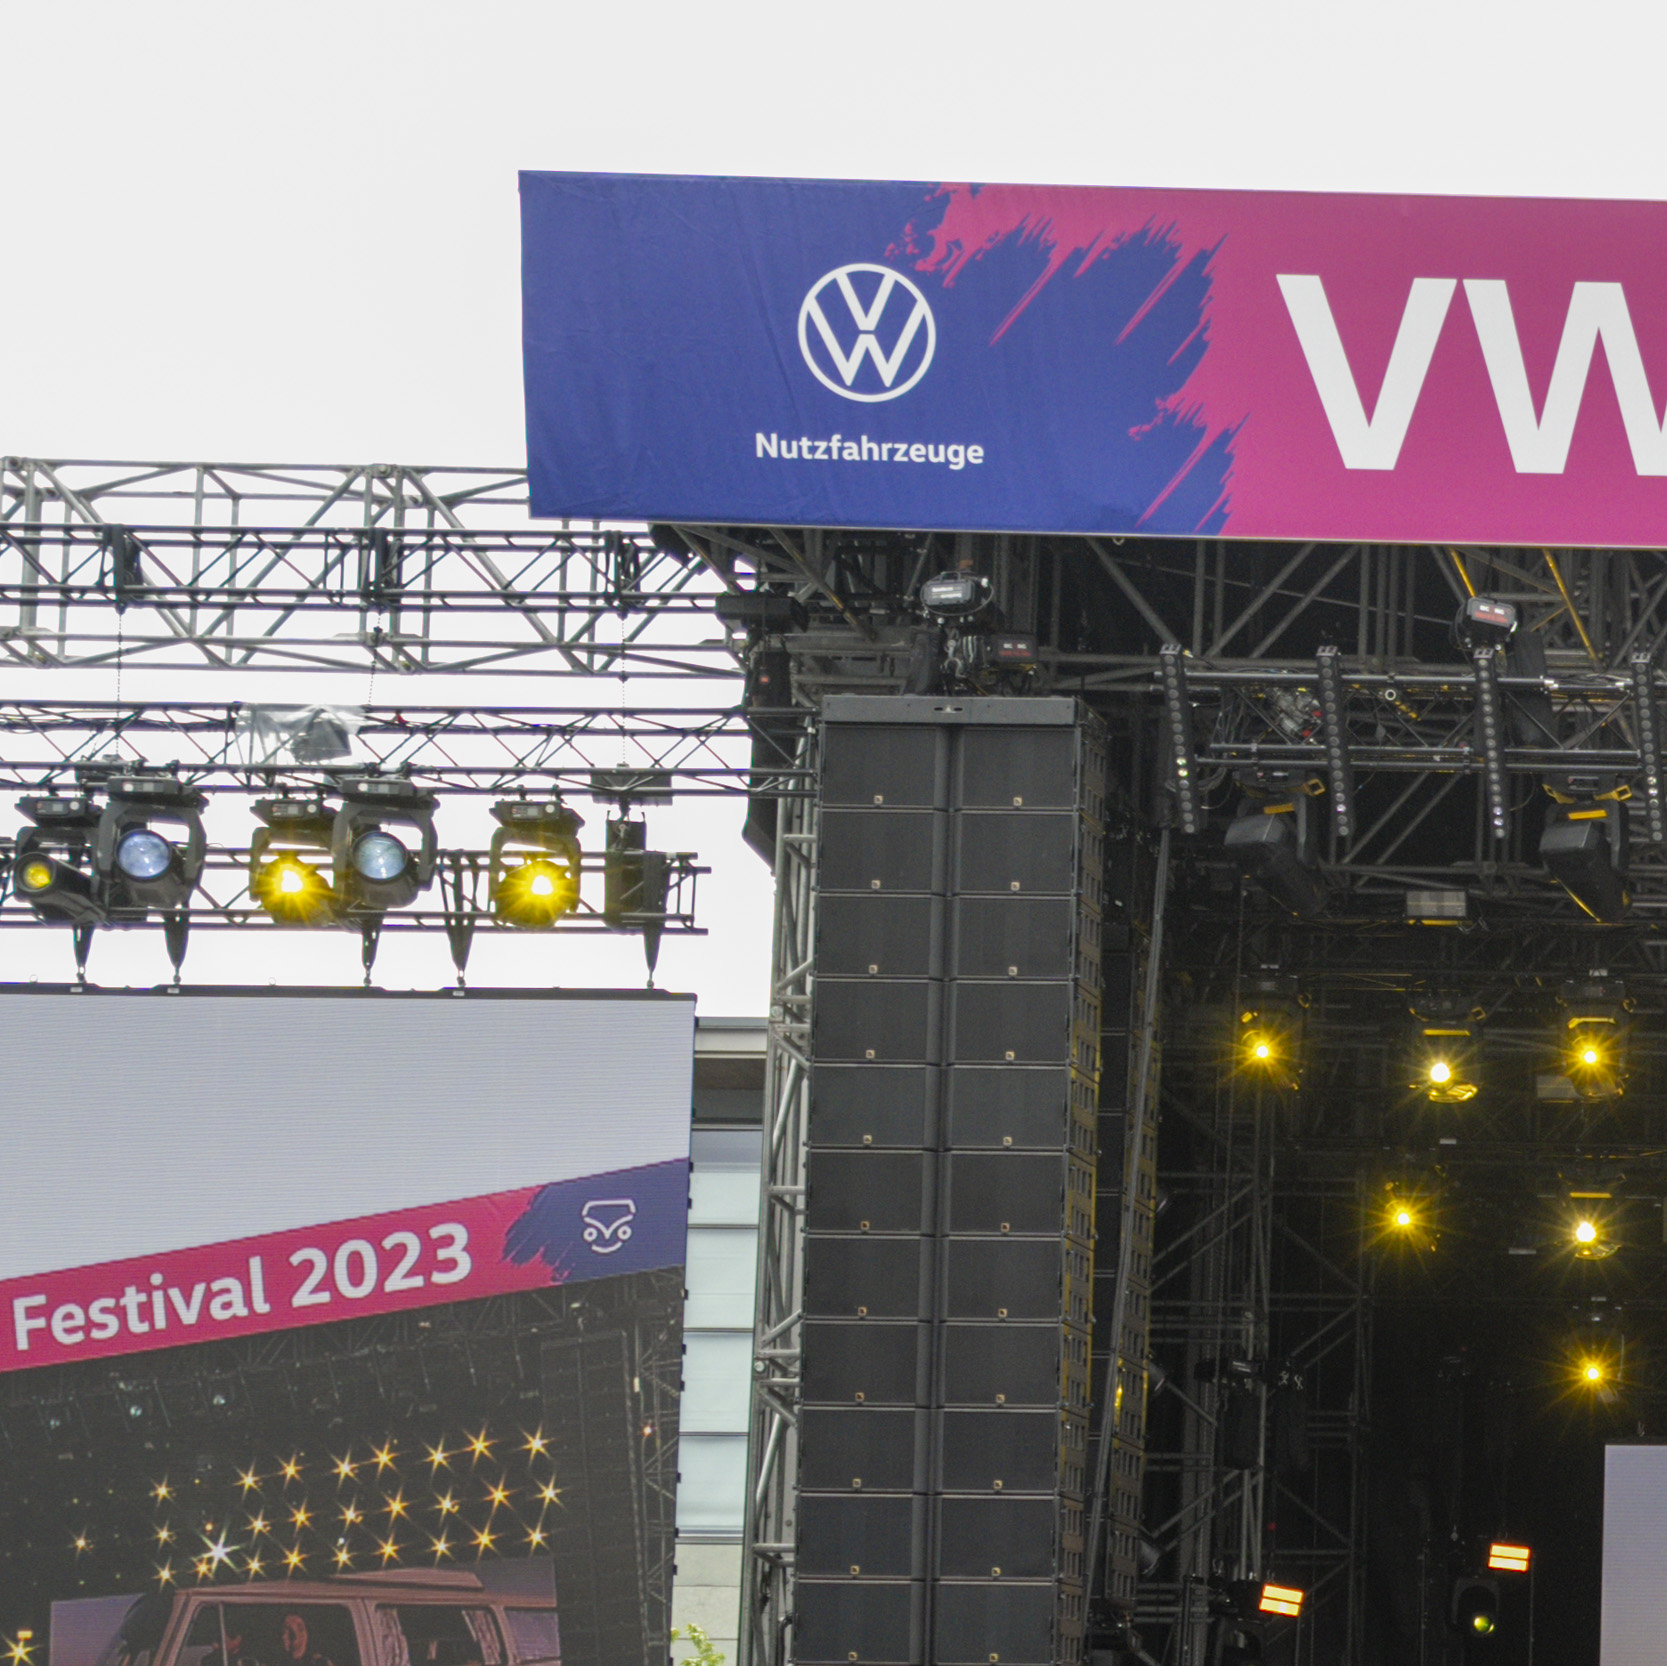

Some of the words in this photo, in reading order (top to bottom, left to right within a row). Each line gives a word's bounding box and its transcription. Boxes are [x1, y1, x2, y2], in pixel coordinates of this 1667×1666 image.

[754, 432, 985, 472] Nutzfahrzeuge
[12, 1256, 271, 1351] Festival
[289, 1222, 473, 1308] 2023
